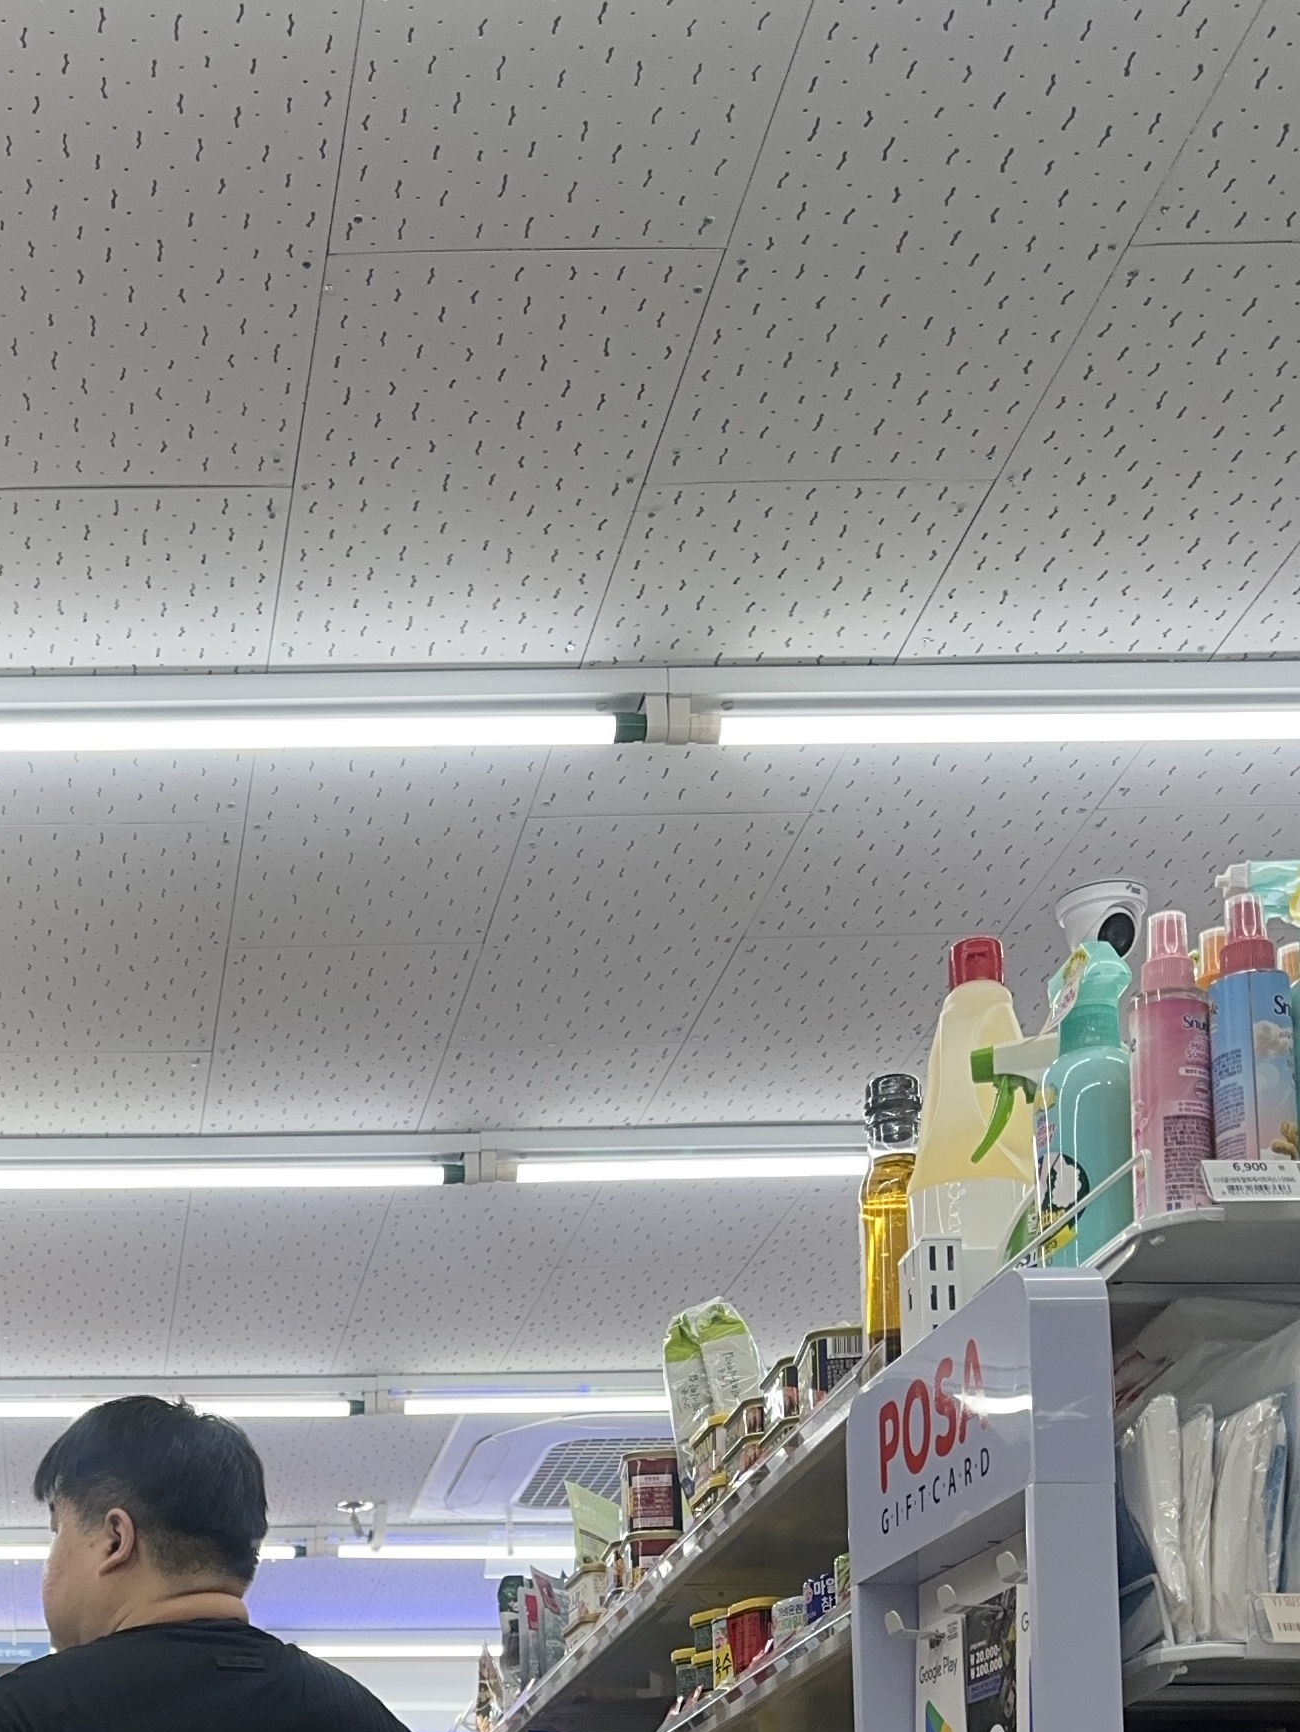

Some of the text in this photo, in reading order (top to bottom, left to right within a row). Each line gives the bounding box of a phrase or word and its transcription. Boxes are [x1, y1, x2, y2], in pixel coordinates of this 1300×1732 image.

[1232, 1162, 1268, 1173] 6,900
[879, 1338, 989, 1494] POSA
[919, 1655, 958, 1685] Google Play
